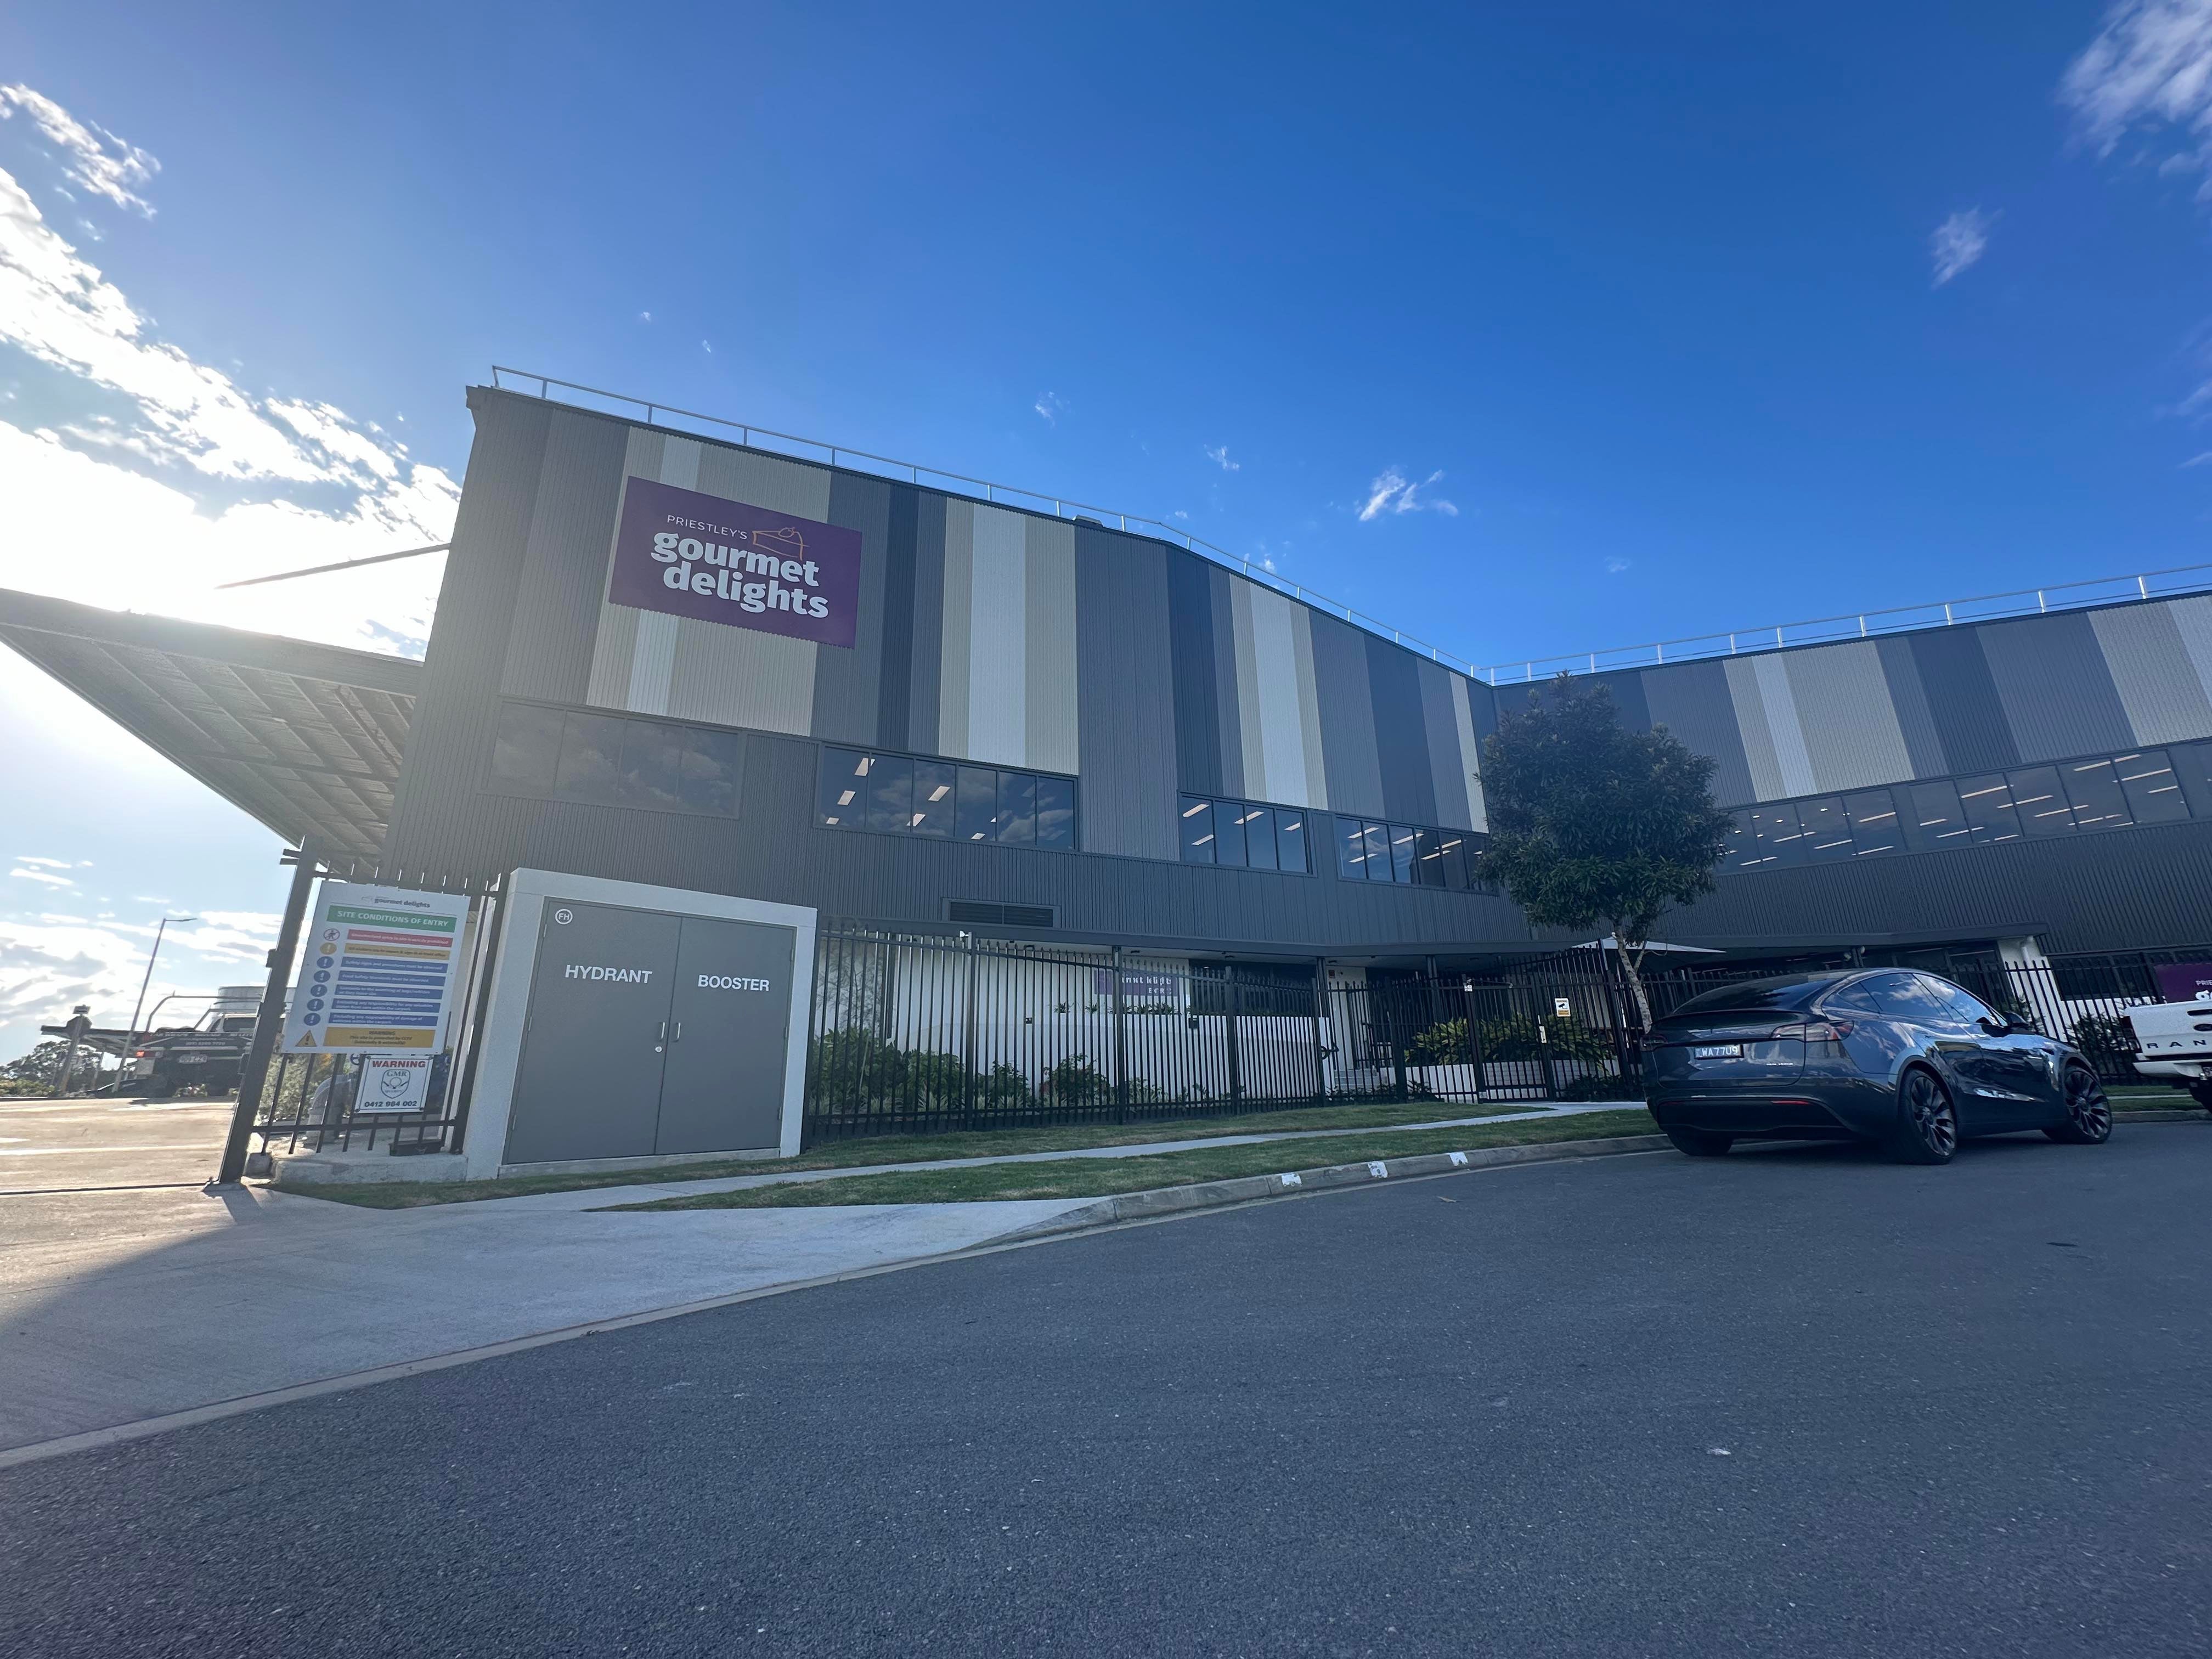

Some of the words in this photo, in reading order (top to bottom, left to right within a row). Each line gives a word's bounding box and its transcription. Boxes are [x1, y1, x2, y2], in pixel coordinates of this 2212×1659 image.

[667, 515, 748, 540] PRIESTLEY'S
[650, 532, 820, 587] gourmet
[663, 561, 829, 619] delights
[374, 898, 403, 906] gourmet
[358, 912, 409, 923] CONDITIONS
[558, 912, 570, 921] FH
[565, 964, 653, 984] HYDRANT
[698, 974, 770, 992] BOOSTER
